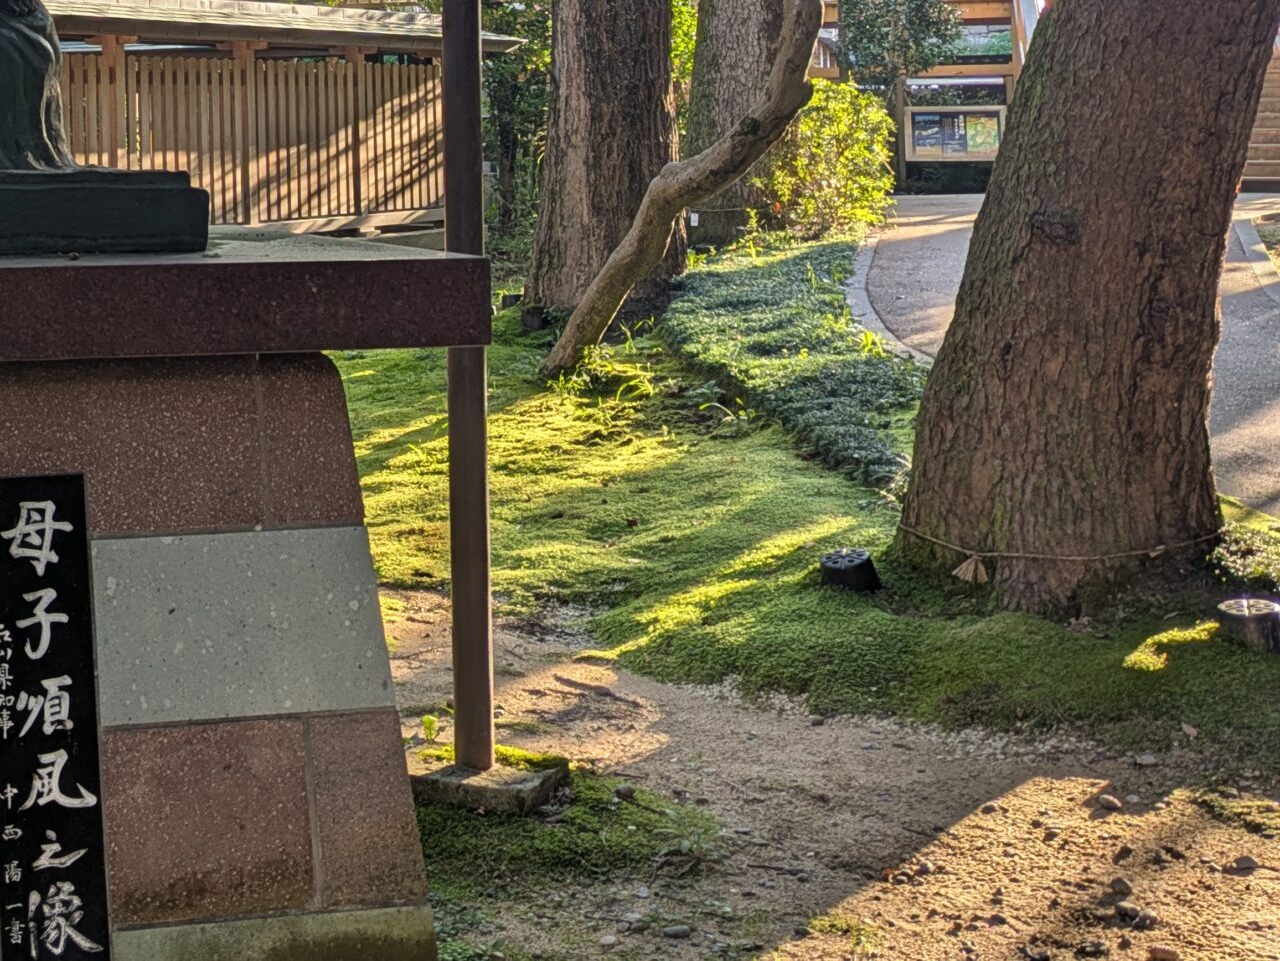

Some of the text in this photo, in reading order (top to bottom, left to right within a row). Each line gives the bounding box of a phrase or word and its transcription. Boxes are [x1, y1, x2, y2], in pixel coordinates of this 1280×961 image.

[0, 500, 104, 960] 母子順風之像
